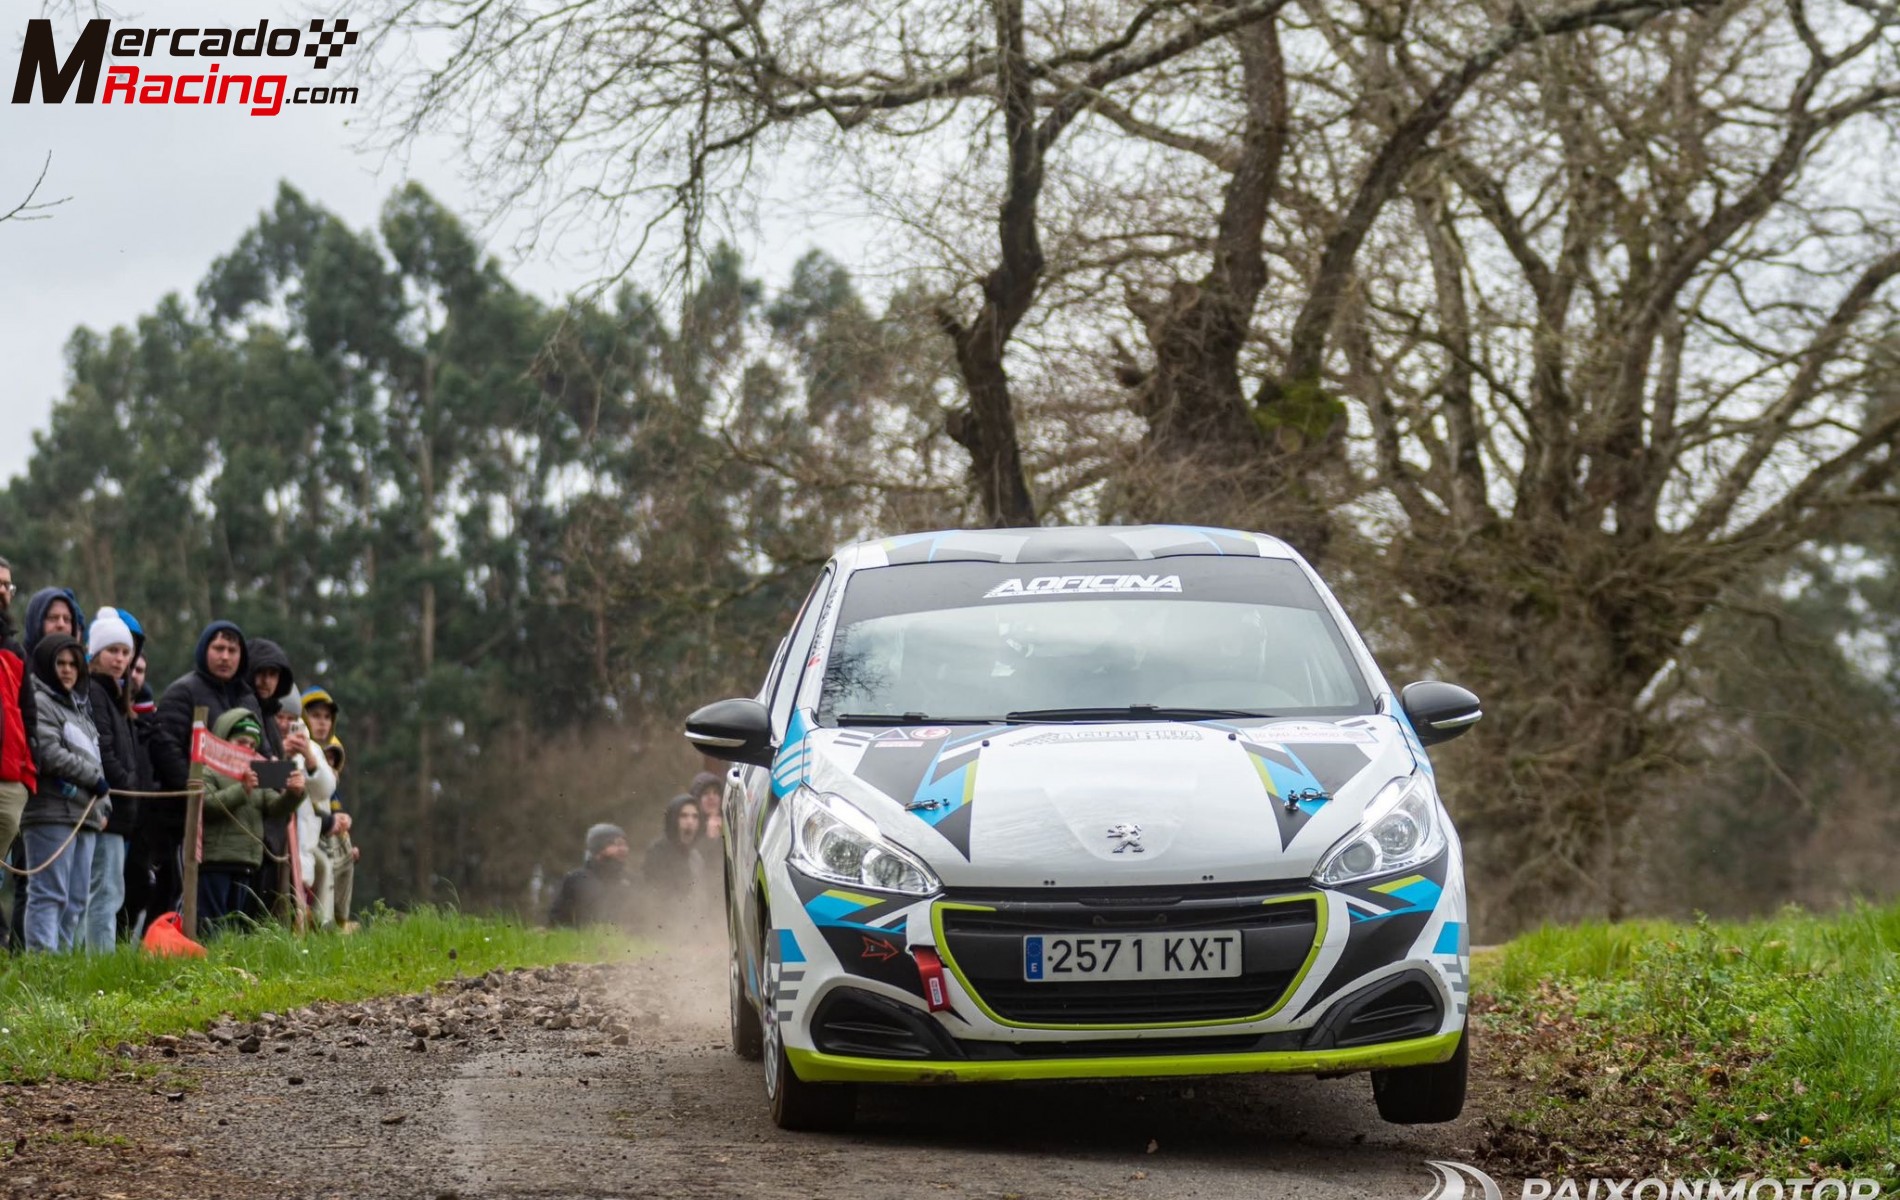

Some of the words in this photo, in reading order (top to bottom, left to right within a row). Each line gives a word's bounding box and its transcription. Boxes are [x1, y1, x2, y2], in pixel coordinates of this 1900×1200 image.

[1051, 939, 1143, 973] 2571
[1164, 937, 1234, 972] KXT
[1031, 963, 1038, 972] E
